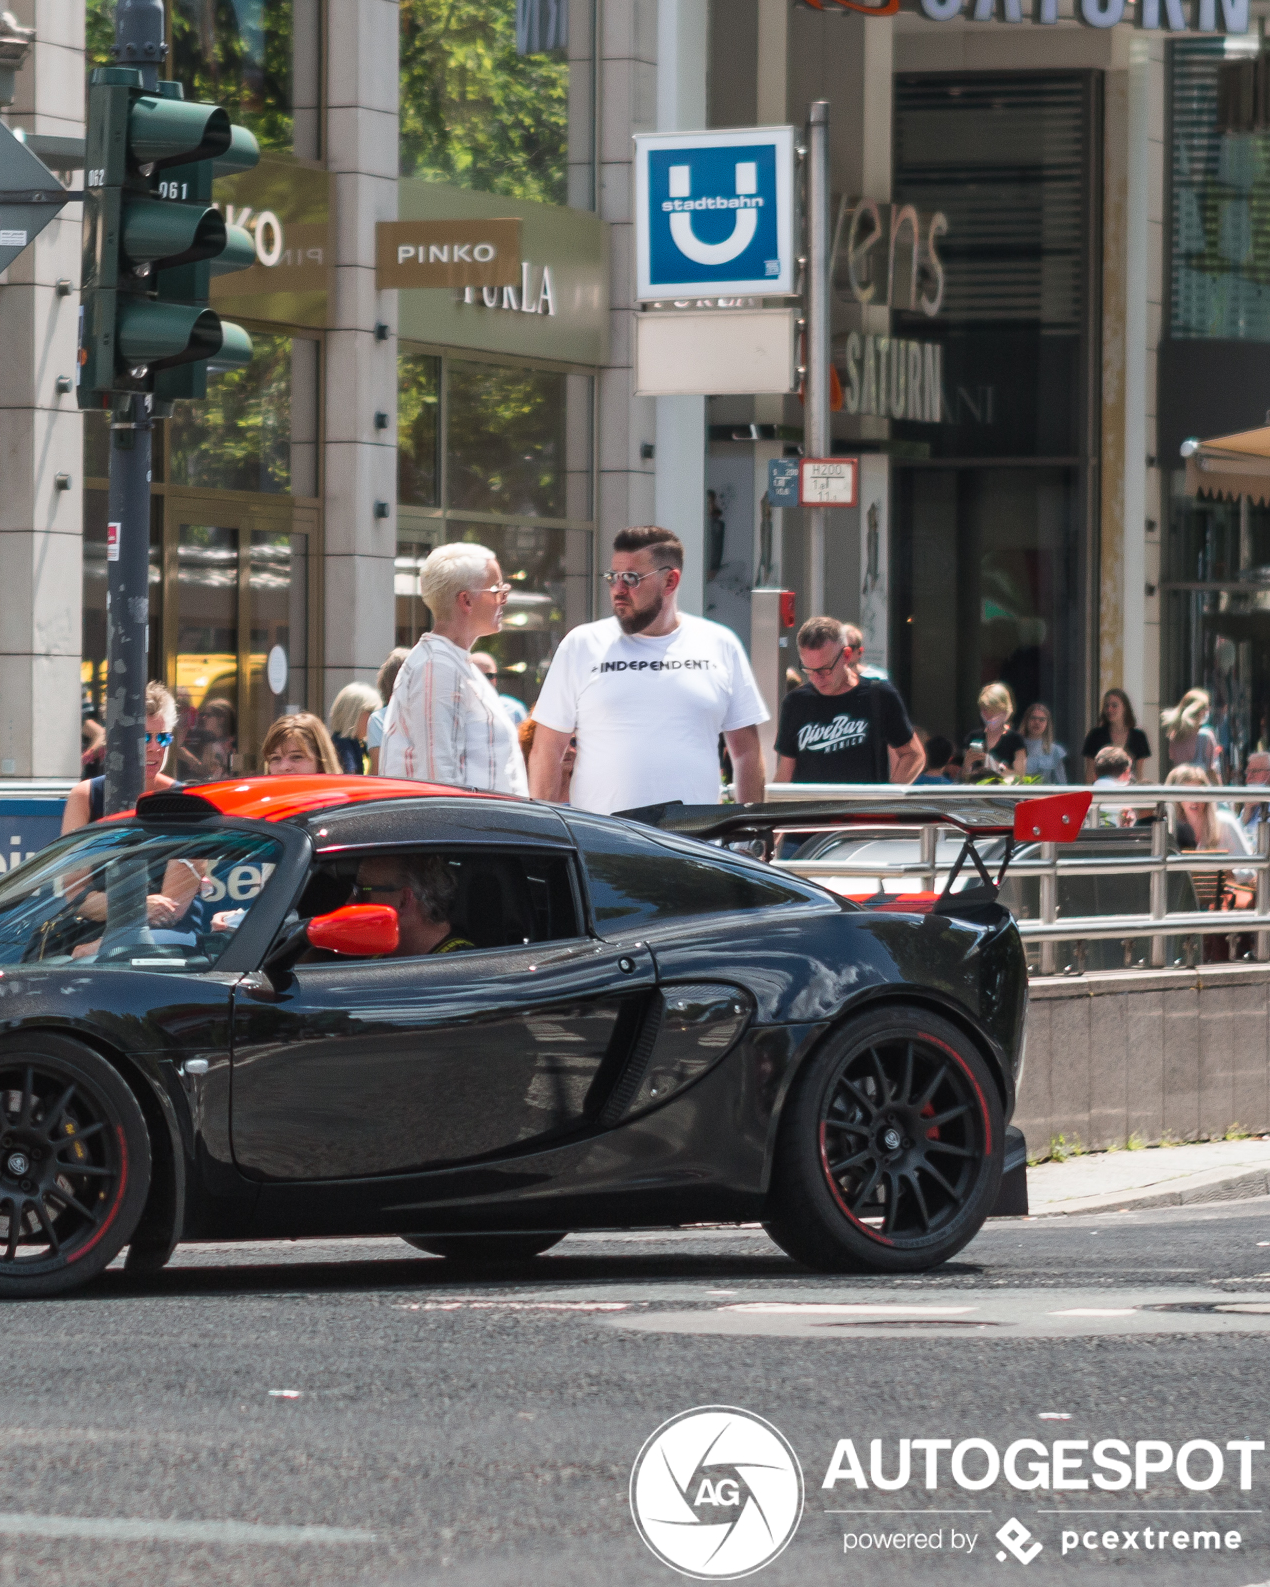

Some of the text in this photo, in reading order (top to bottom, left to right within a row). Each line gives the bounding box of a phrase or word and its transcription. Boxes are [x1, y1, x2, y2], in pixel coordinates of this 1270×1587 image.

[88, 168, 105, 187] 062
[661, 195, 765, 213] stadtbahn
[397, 243, 495, 265] PINKO
[845, 331, 942, 423] SATURN
[600, 659, 710, 674] INDEPENDENT
